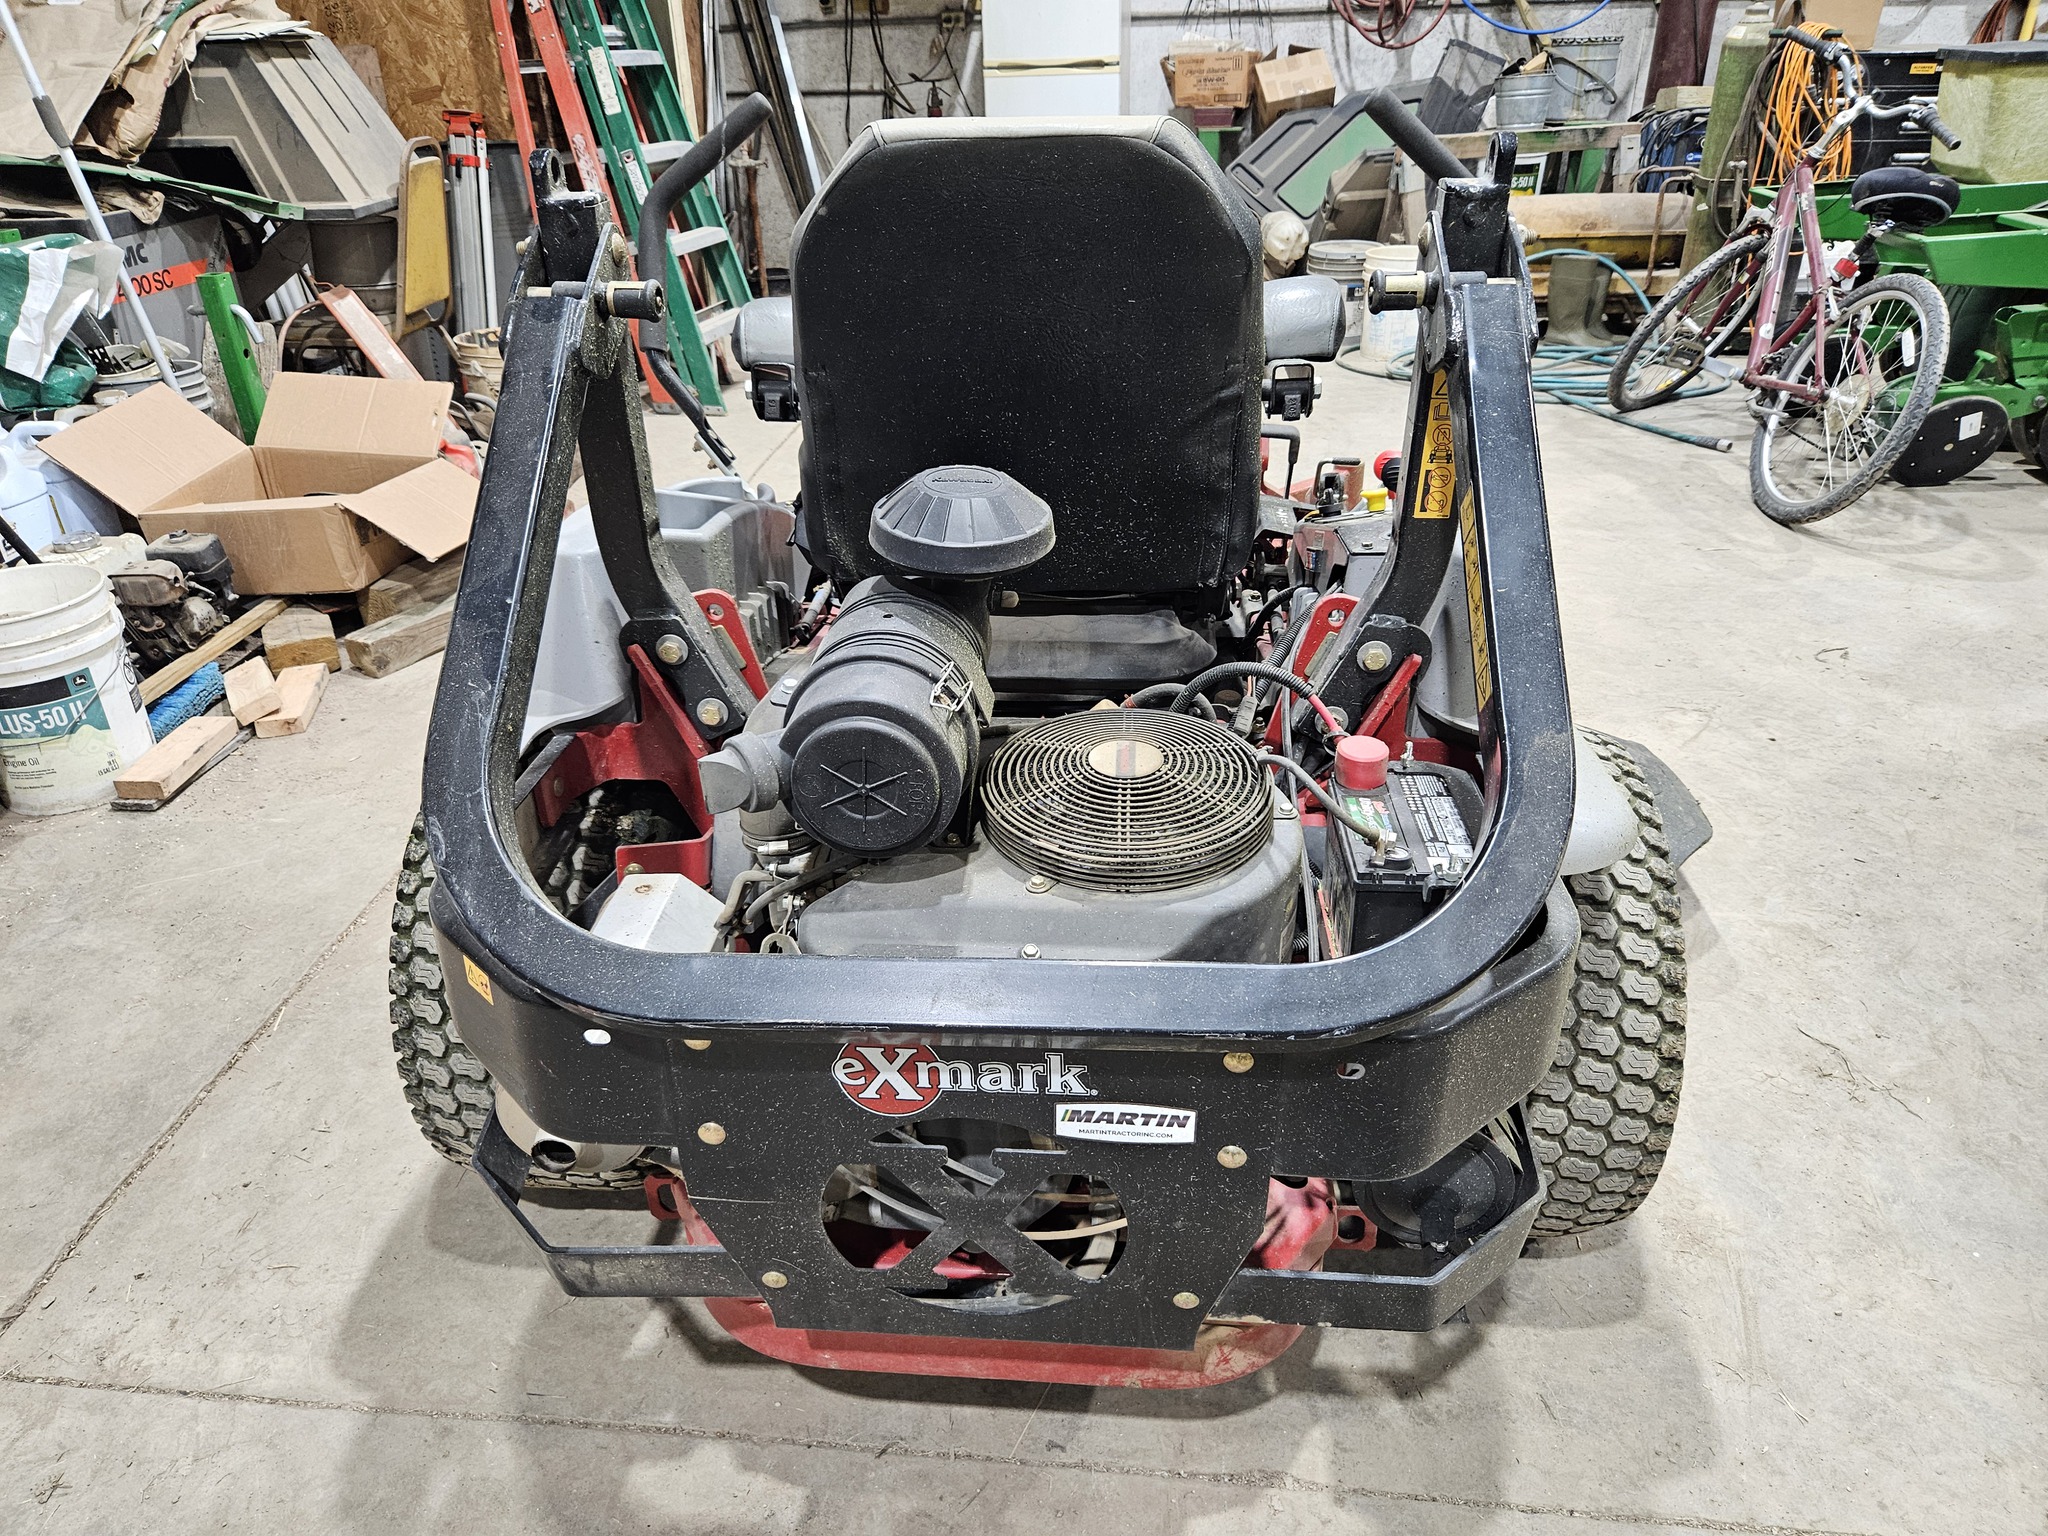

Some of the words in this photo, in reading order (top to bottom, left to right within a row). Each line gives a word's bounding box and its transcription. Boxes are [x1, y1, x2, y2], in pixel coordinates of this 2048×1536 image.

[1511, 176, 1528, 189] S-50
[152, 268, 174, 292] SC
[0, 706, 68, 735] LUS-50
[3, 756, 27, 768] Engine
[28, 757, 40, 767] Oil
[1067, 1109, 1192, 1128] MARTIN
[1078, 1128, 1174, 1139] MARTINTRACTORINC.COM
